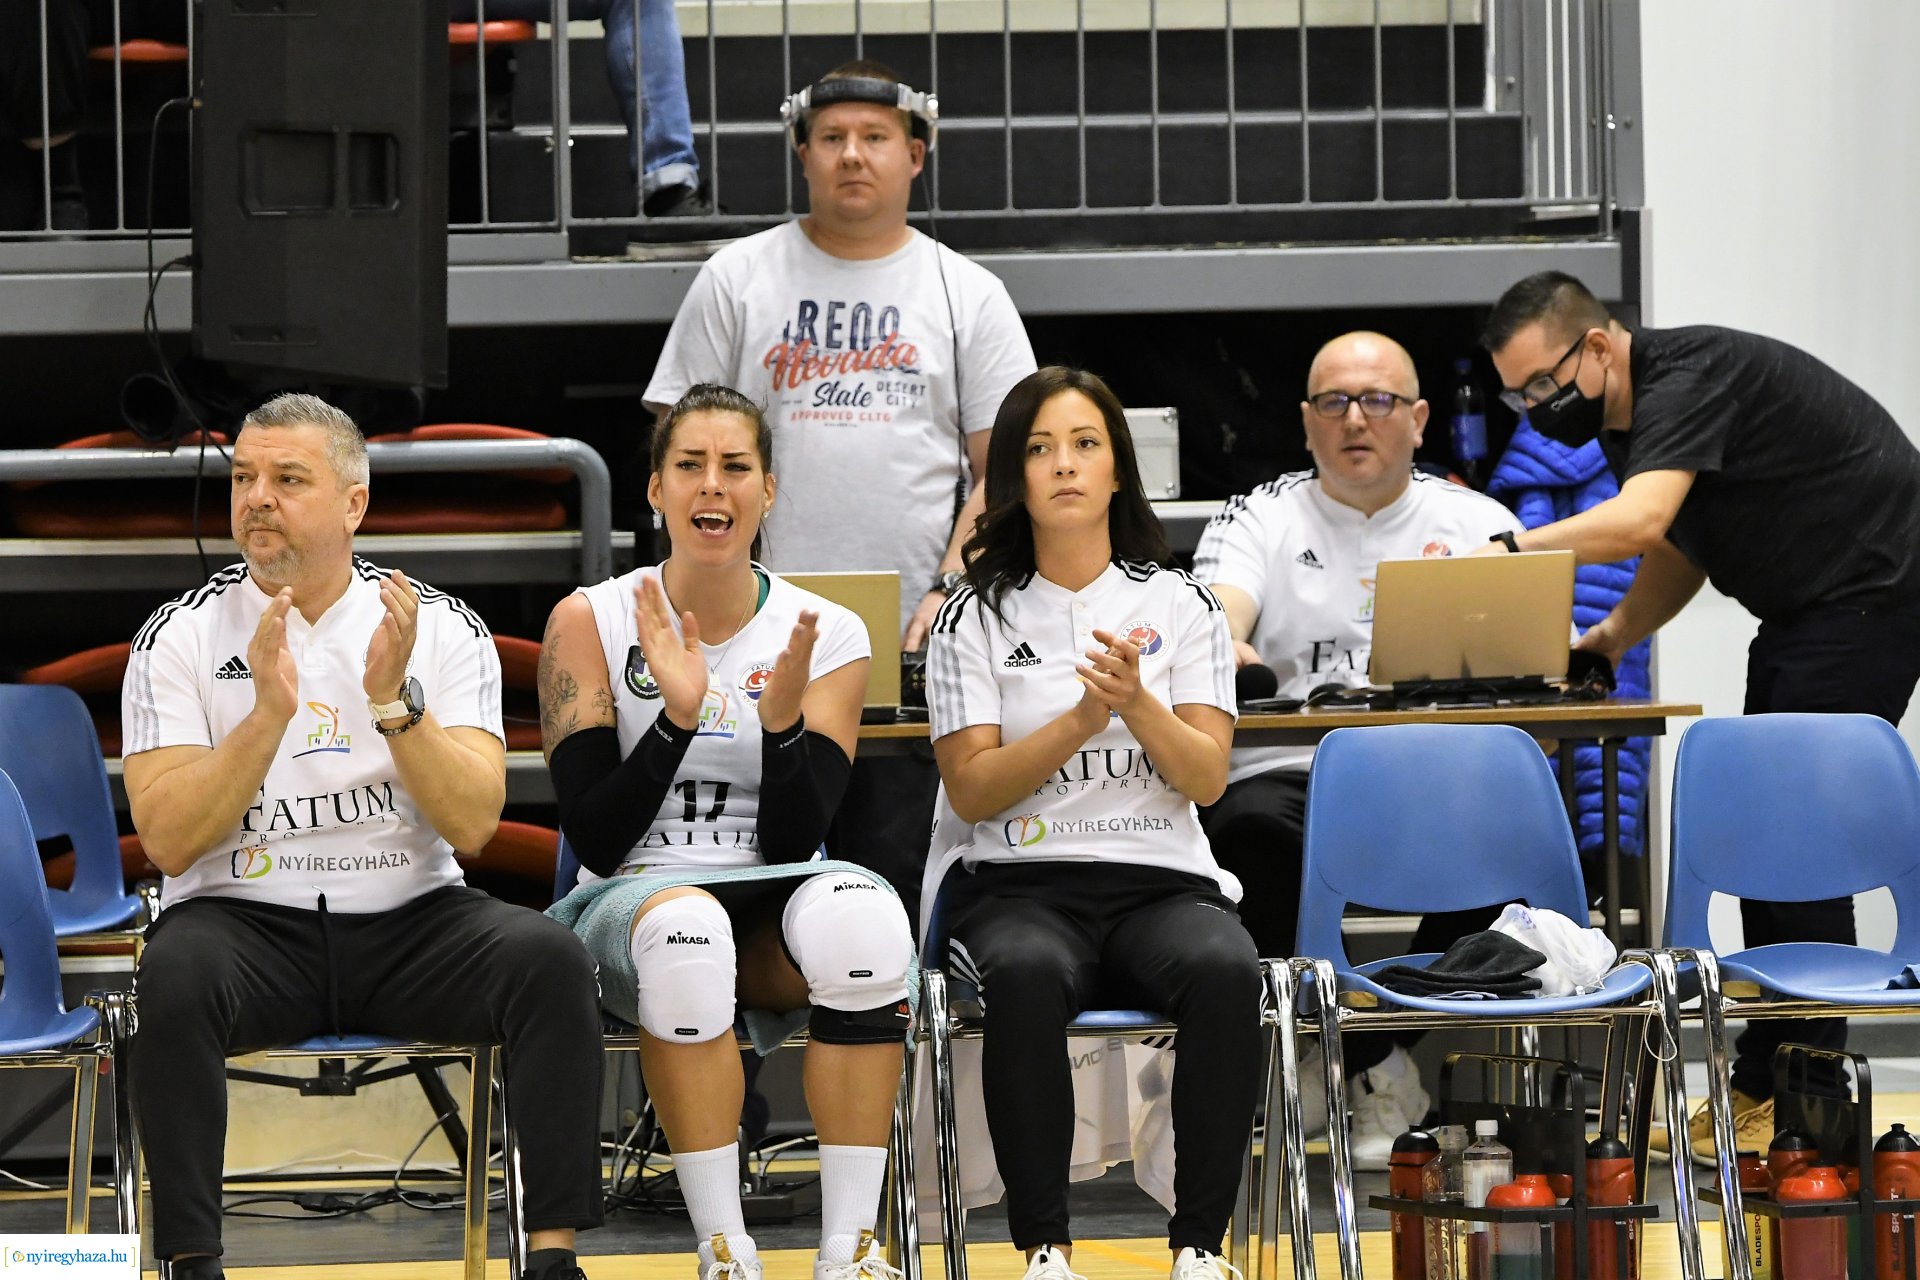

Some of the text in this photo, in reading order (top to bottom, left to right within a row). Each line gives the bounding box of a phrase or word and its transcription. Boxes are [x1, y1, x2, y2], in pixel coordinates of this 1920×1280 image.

[797, 300, 900, 350] RENO
[763, 331, 919, 392] Nevada
[813, 380, 872, 408] State
[876, 380, 926, 396] DESERT
[886, 394, 917, 409] CITY
[790, 409, 853, 422] APPROVED
[1004, 657, 1042, 668] adidas
[1034, 778, 1167, 796] ROPERT
[241, 781, 397, 832] FATUM
[675, 779, 732, 823] 17
[1052, 816, 1173, 833] NYÍREGYHÁZA
[278, 852, 411, 871] NYÍREGYHÁZA
[1754, 1214, 1763, 1267] BLADESPO
